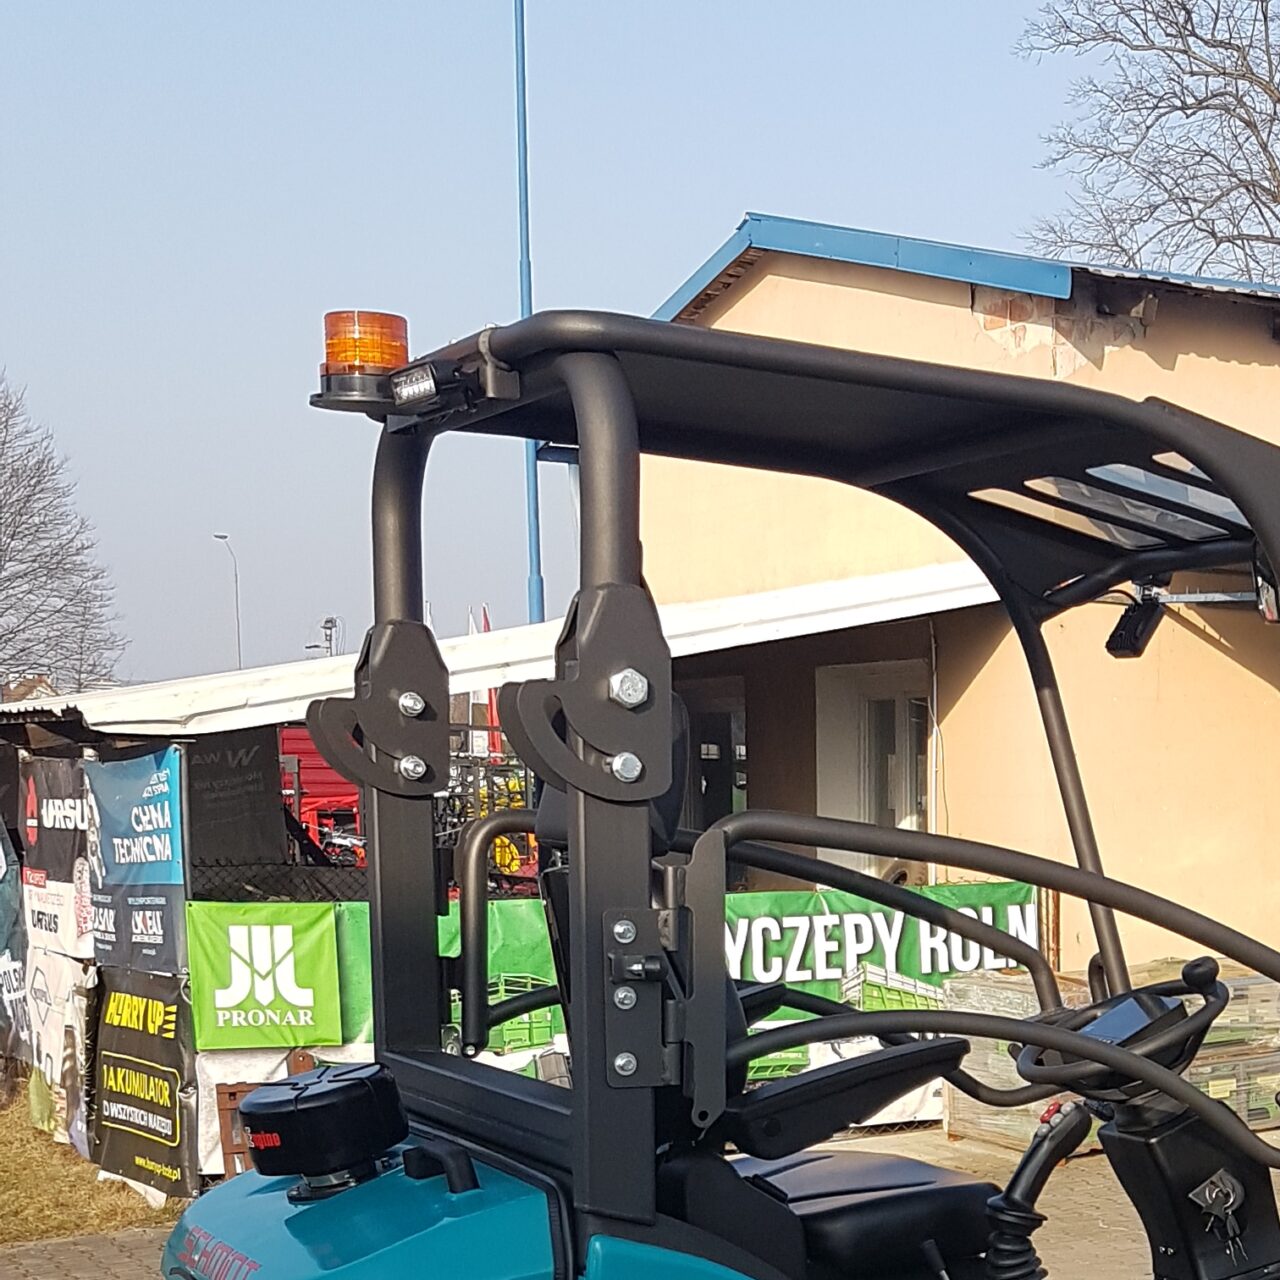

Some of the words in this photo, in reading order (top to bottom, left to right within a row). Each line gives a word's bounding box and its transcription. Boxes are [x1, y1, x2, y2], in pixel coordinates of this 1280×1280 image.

[105, 990, 148, 1031] HURRY
[147, 998, 165, 1035] UP
[216, 1008, 315, 1027] PRONAR
